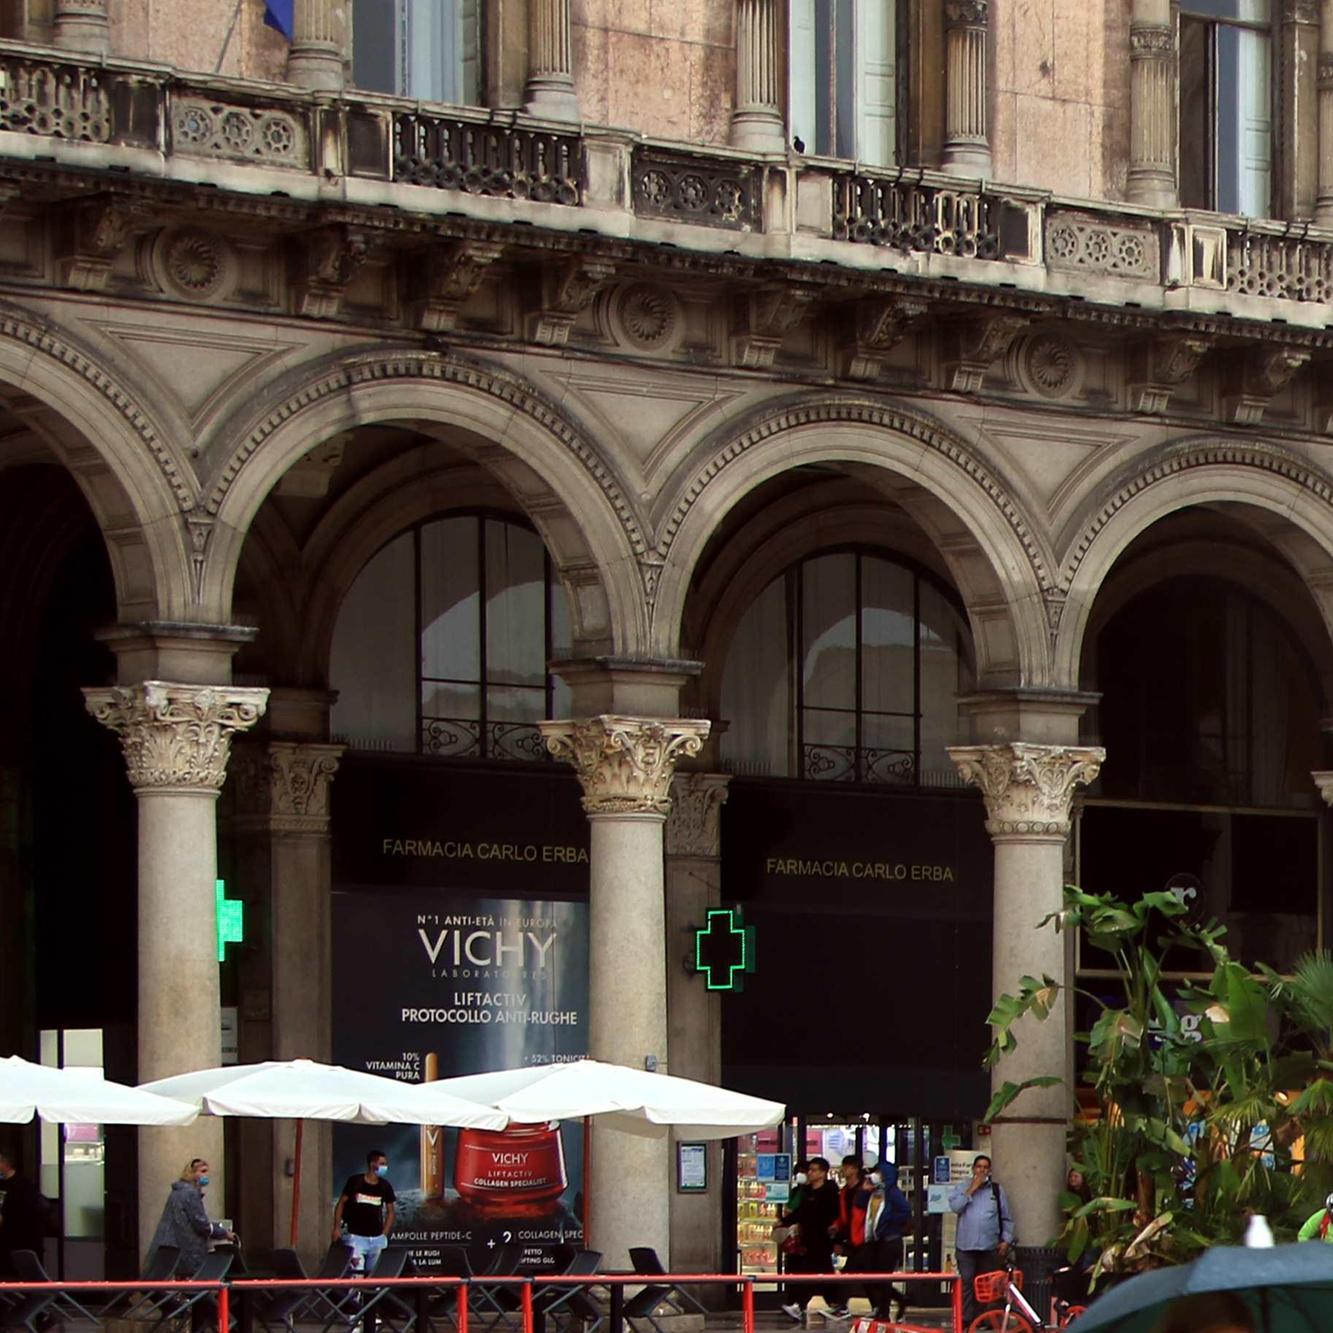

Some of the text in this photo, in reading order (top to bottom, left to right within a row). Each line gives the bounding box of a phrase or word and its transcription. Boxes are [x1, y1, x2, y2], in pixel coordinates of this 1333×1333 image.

[383, 838, 589, 863] FARMACIA CARLO ERBA
[766, 857, 955, 882] FARMACIA CARLO ERBA
[444, 913, 495, 927] ANTI-ETÀ
[418, 928, 558, 968] VICHY
[453, 992, 528, 1007] LIFTACTIV
[402, 1008, 577, 1026] PROTOCOLLO ANTI-RUGHE
[402, 1052, 420, 1062] 10%
[366, 1061, 420, 1071] VITAMINA C
[395, 1071, 420, 1080] PURA
[492, 1152, 529, 1164] VICHY
[488, 1169, 533, 1178] LIFTACTIV
[474, 1177, 547, 1187] COLLAGEN SPECIALIST
[390, 1230, 472, 1241] AMPOLLE PEPTIDE-C
[518, 1230, 560, 1240] COLLAGEN
